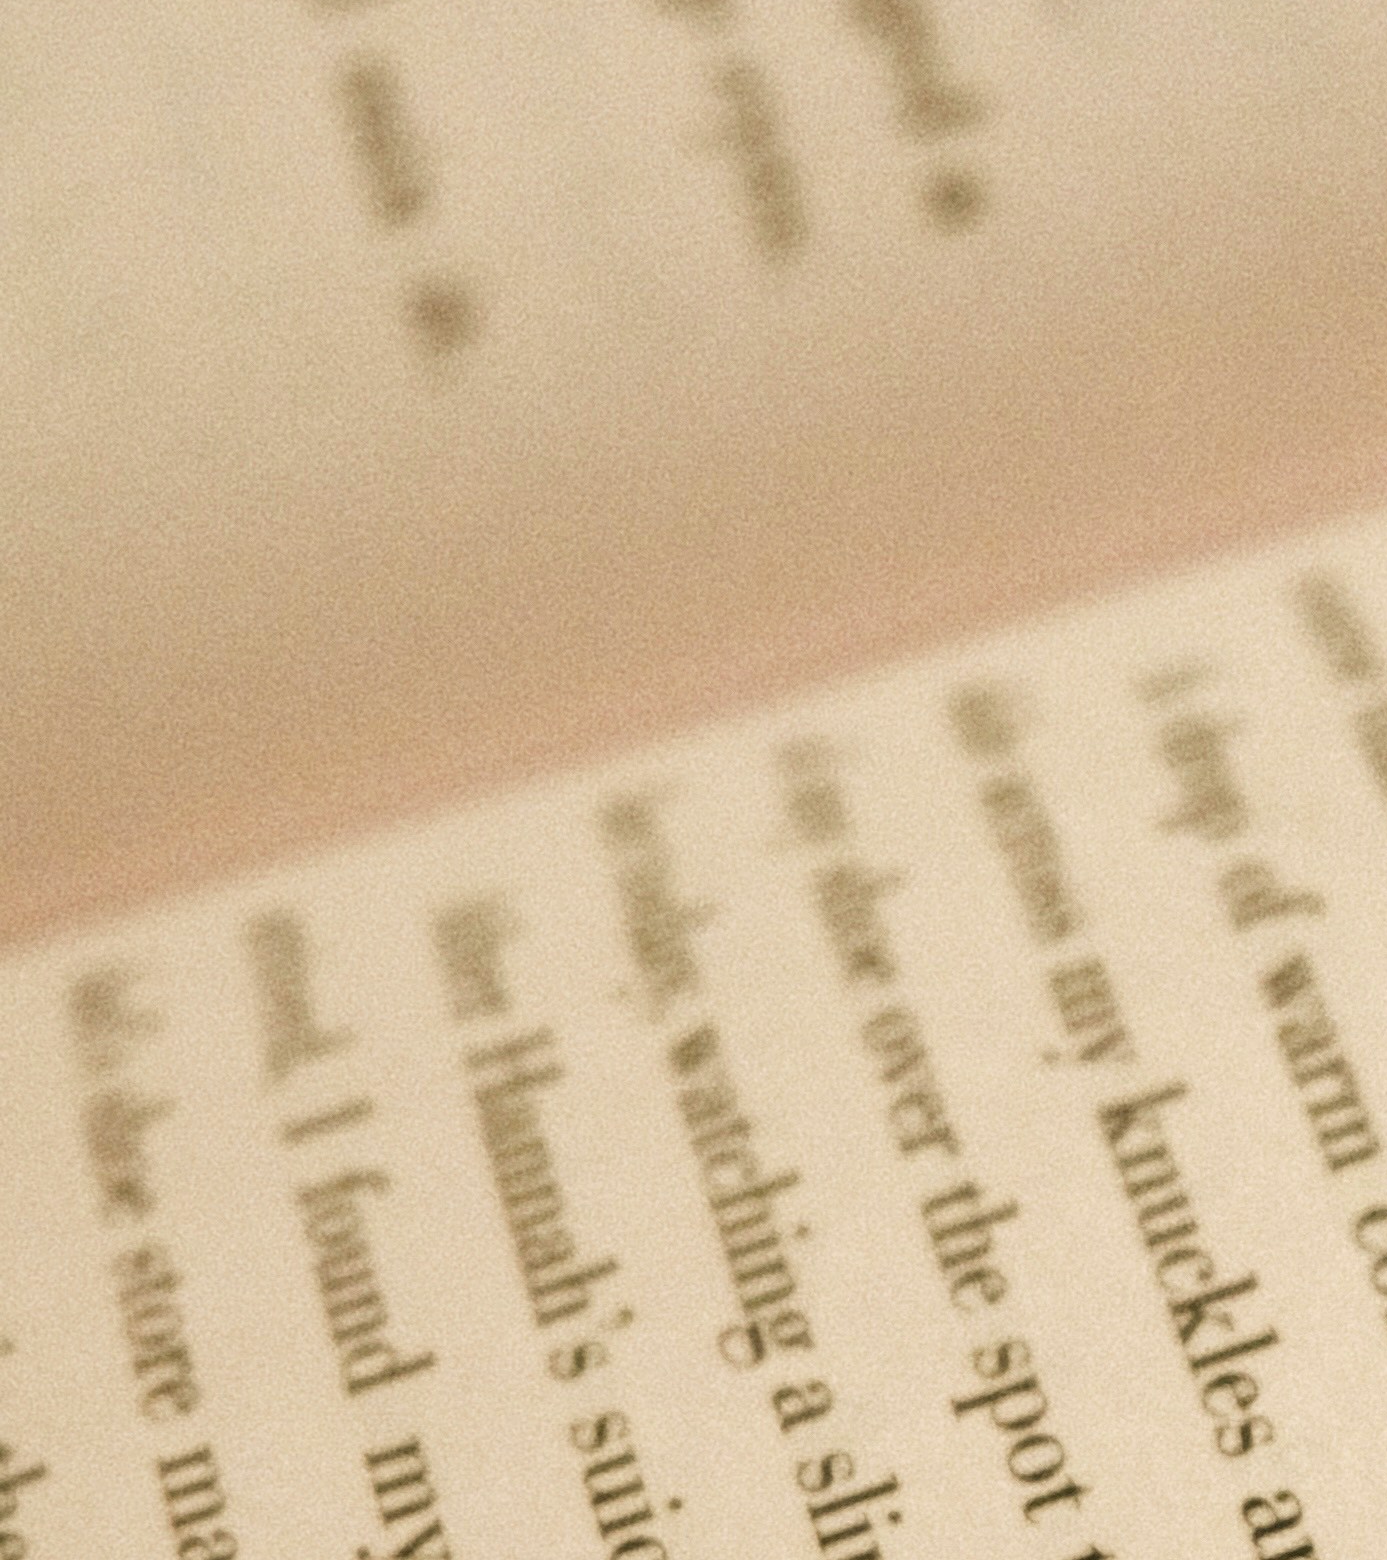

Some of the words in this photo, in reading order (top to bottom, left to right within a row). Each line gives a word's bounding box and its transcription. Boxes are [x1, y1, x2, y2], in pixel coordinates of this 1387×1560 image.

[860, 1005, 962, 1158] over
[1260, 953, 1381, 1175] warm
[295, 1168, 438, 1400] found
[463, 1028, 636, 1384] Hannah’s
[666, 1022, 816, 1368] watching
[770, 1380, 834, 1435] a
[919, 1179, 1020, 1307] the
[1042, 956, 1135, 1067] my
[1097, 1082, 1281, 1459] knuckles
[113, 1243, 202, 1417] store
[950, 1340, 1088, 1522] spot
